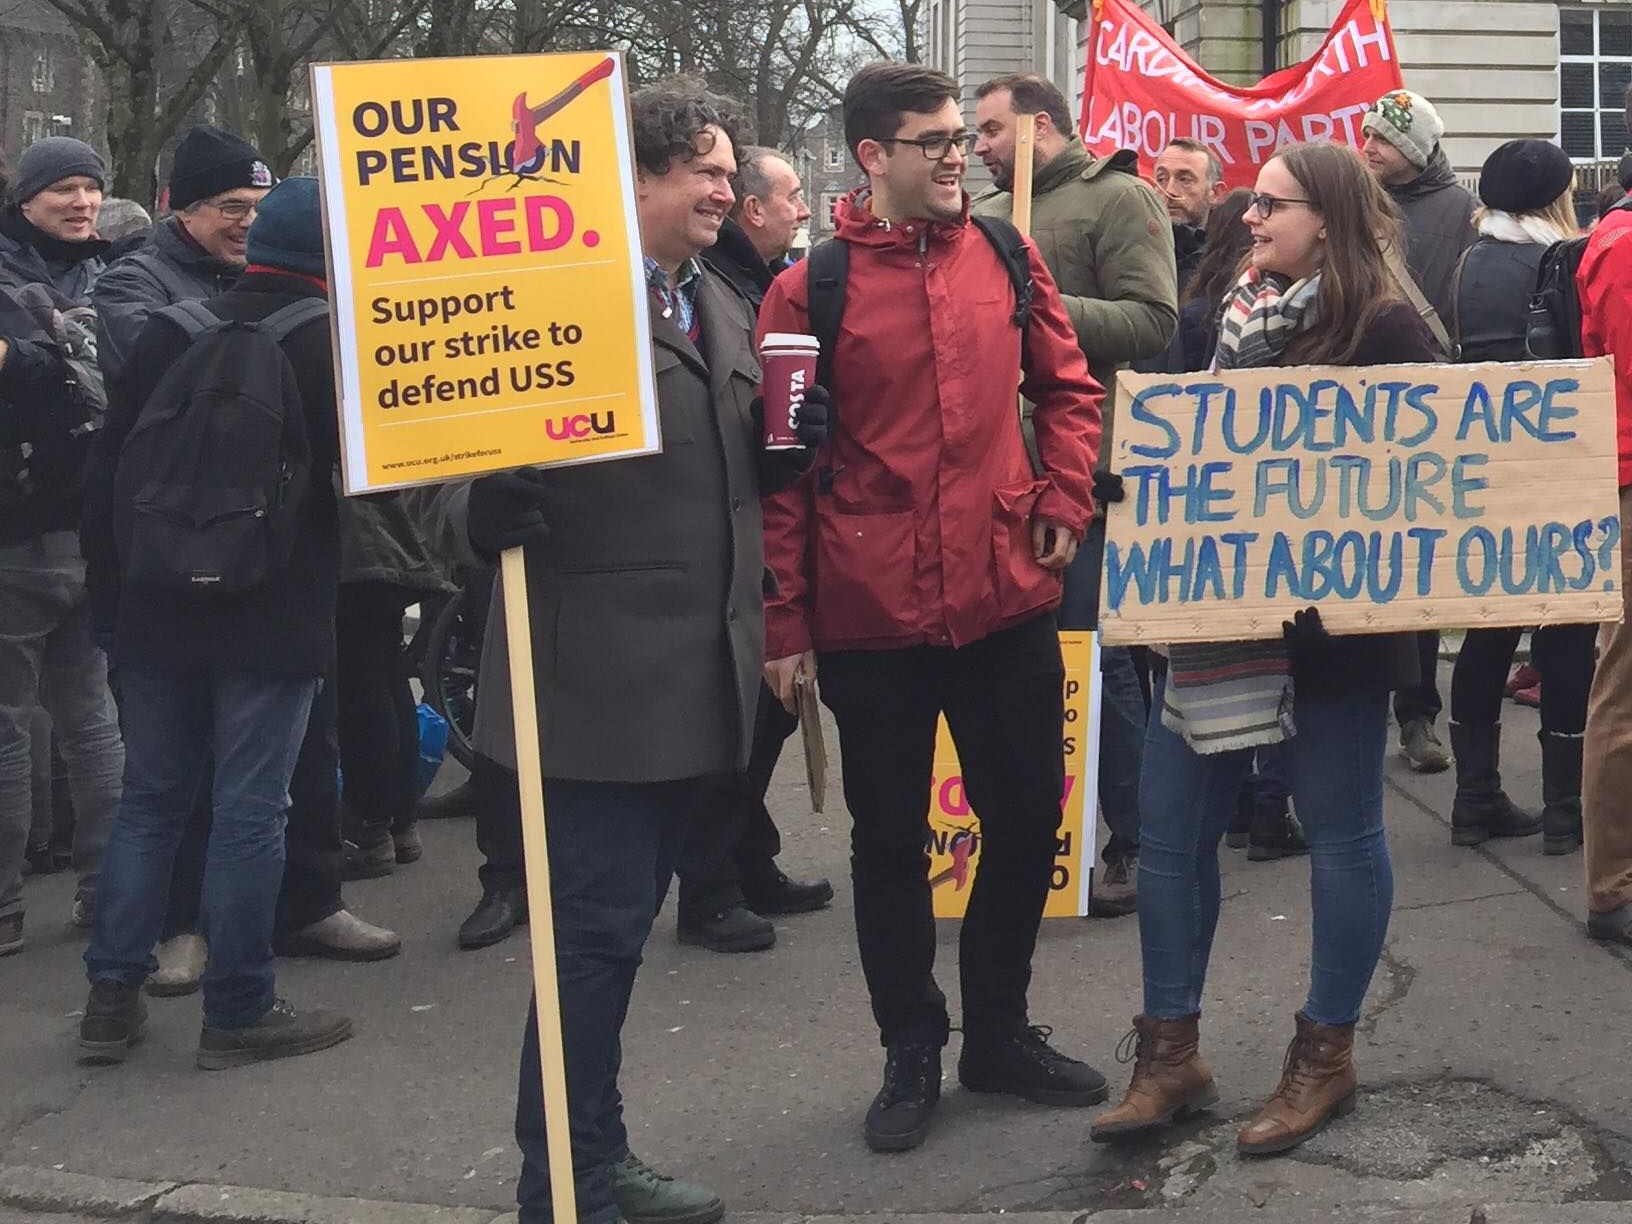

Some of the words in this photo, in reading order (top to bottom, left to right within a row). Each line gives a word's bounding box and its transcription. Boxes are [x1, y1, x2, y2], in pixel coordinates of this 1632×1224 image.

[352, 97, 460, 138] OUR
[1244, 102, 1371, 164] PART
[356, 139, 581, 186] PENSION
[365, 195, 600, 268] AXED.
[371, 285, 515, 326] Support
[374, 337, 436, 367] our
[445, 325, 541, 359] strike
[548, 321, 583, 352] to
[377, 369, 501, 409] defend
[510, 360, 576, 392] USS
[788, 369, 805, 430] COSTA
[1130, 378, 1439, 458] STUDENTS
[1456, 378, 1580, 443] ARE
[1121, 461, 1239, 526] THE
[1253, 451, 1490, 521] FUTURE
[1106, 531, 1258, 612] WHAT
[1265, 528, 1447, 604] ABOUT
[1456, 515, 1621, 595] OURS?
